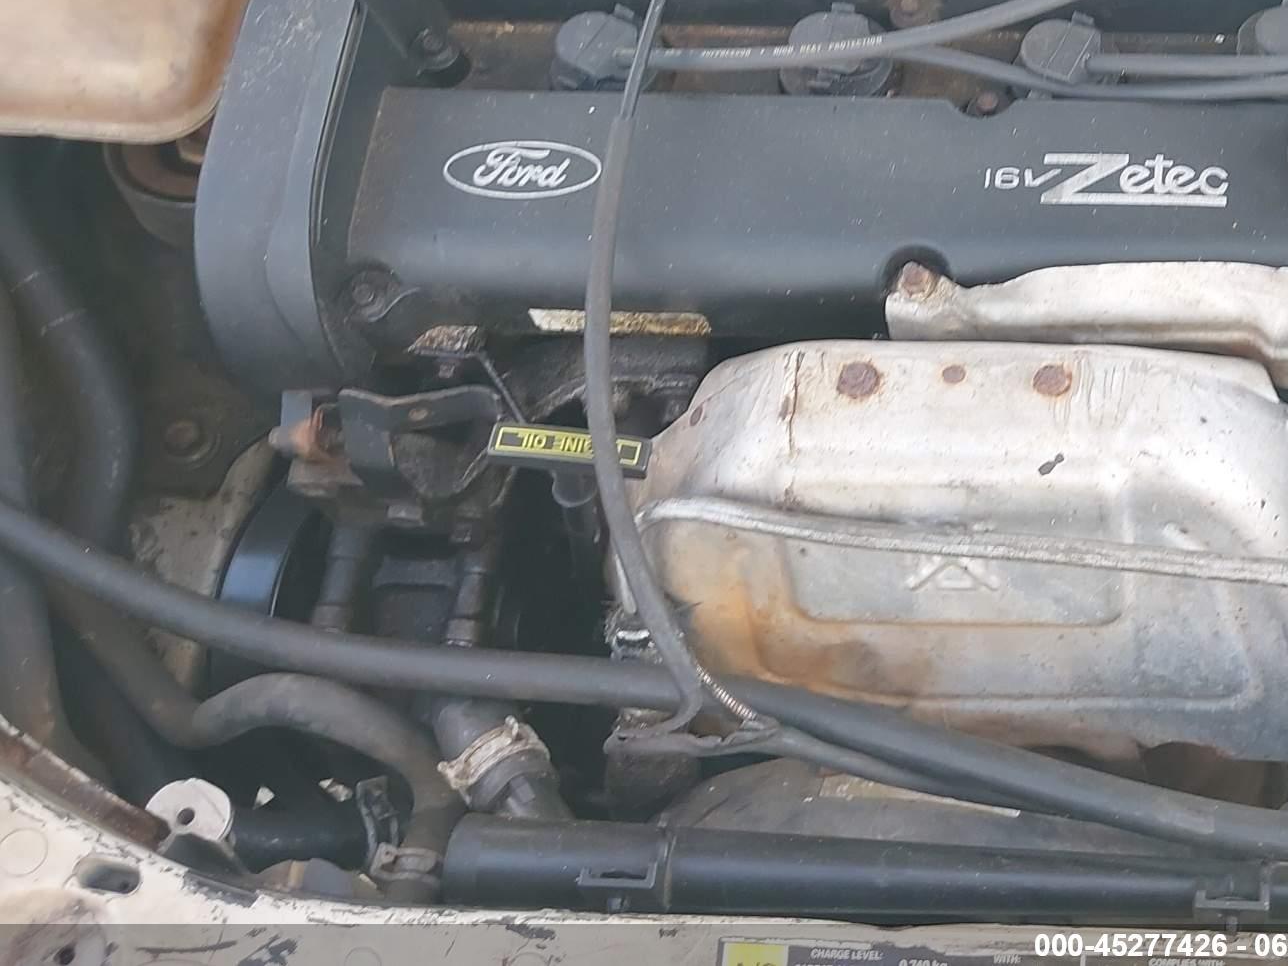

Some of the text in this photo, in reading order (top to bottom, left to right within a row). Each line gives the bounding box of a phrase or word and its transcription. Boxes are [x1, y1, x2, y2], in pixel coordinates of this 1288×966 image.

[472, 146, 571, 187] Ford
[1041, 153, 1229, 207] Zetec
[518, 434, 547, 450] OIL
[811, 948, 850, 960] CHARGE
